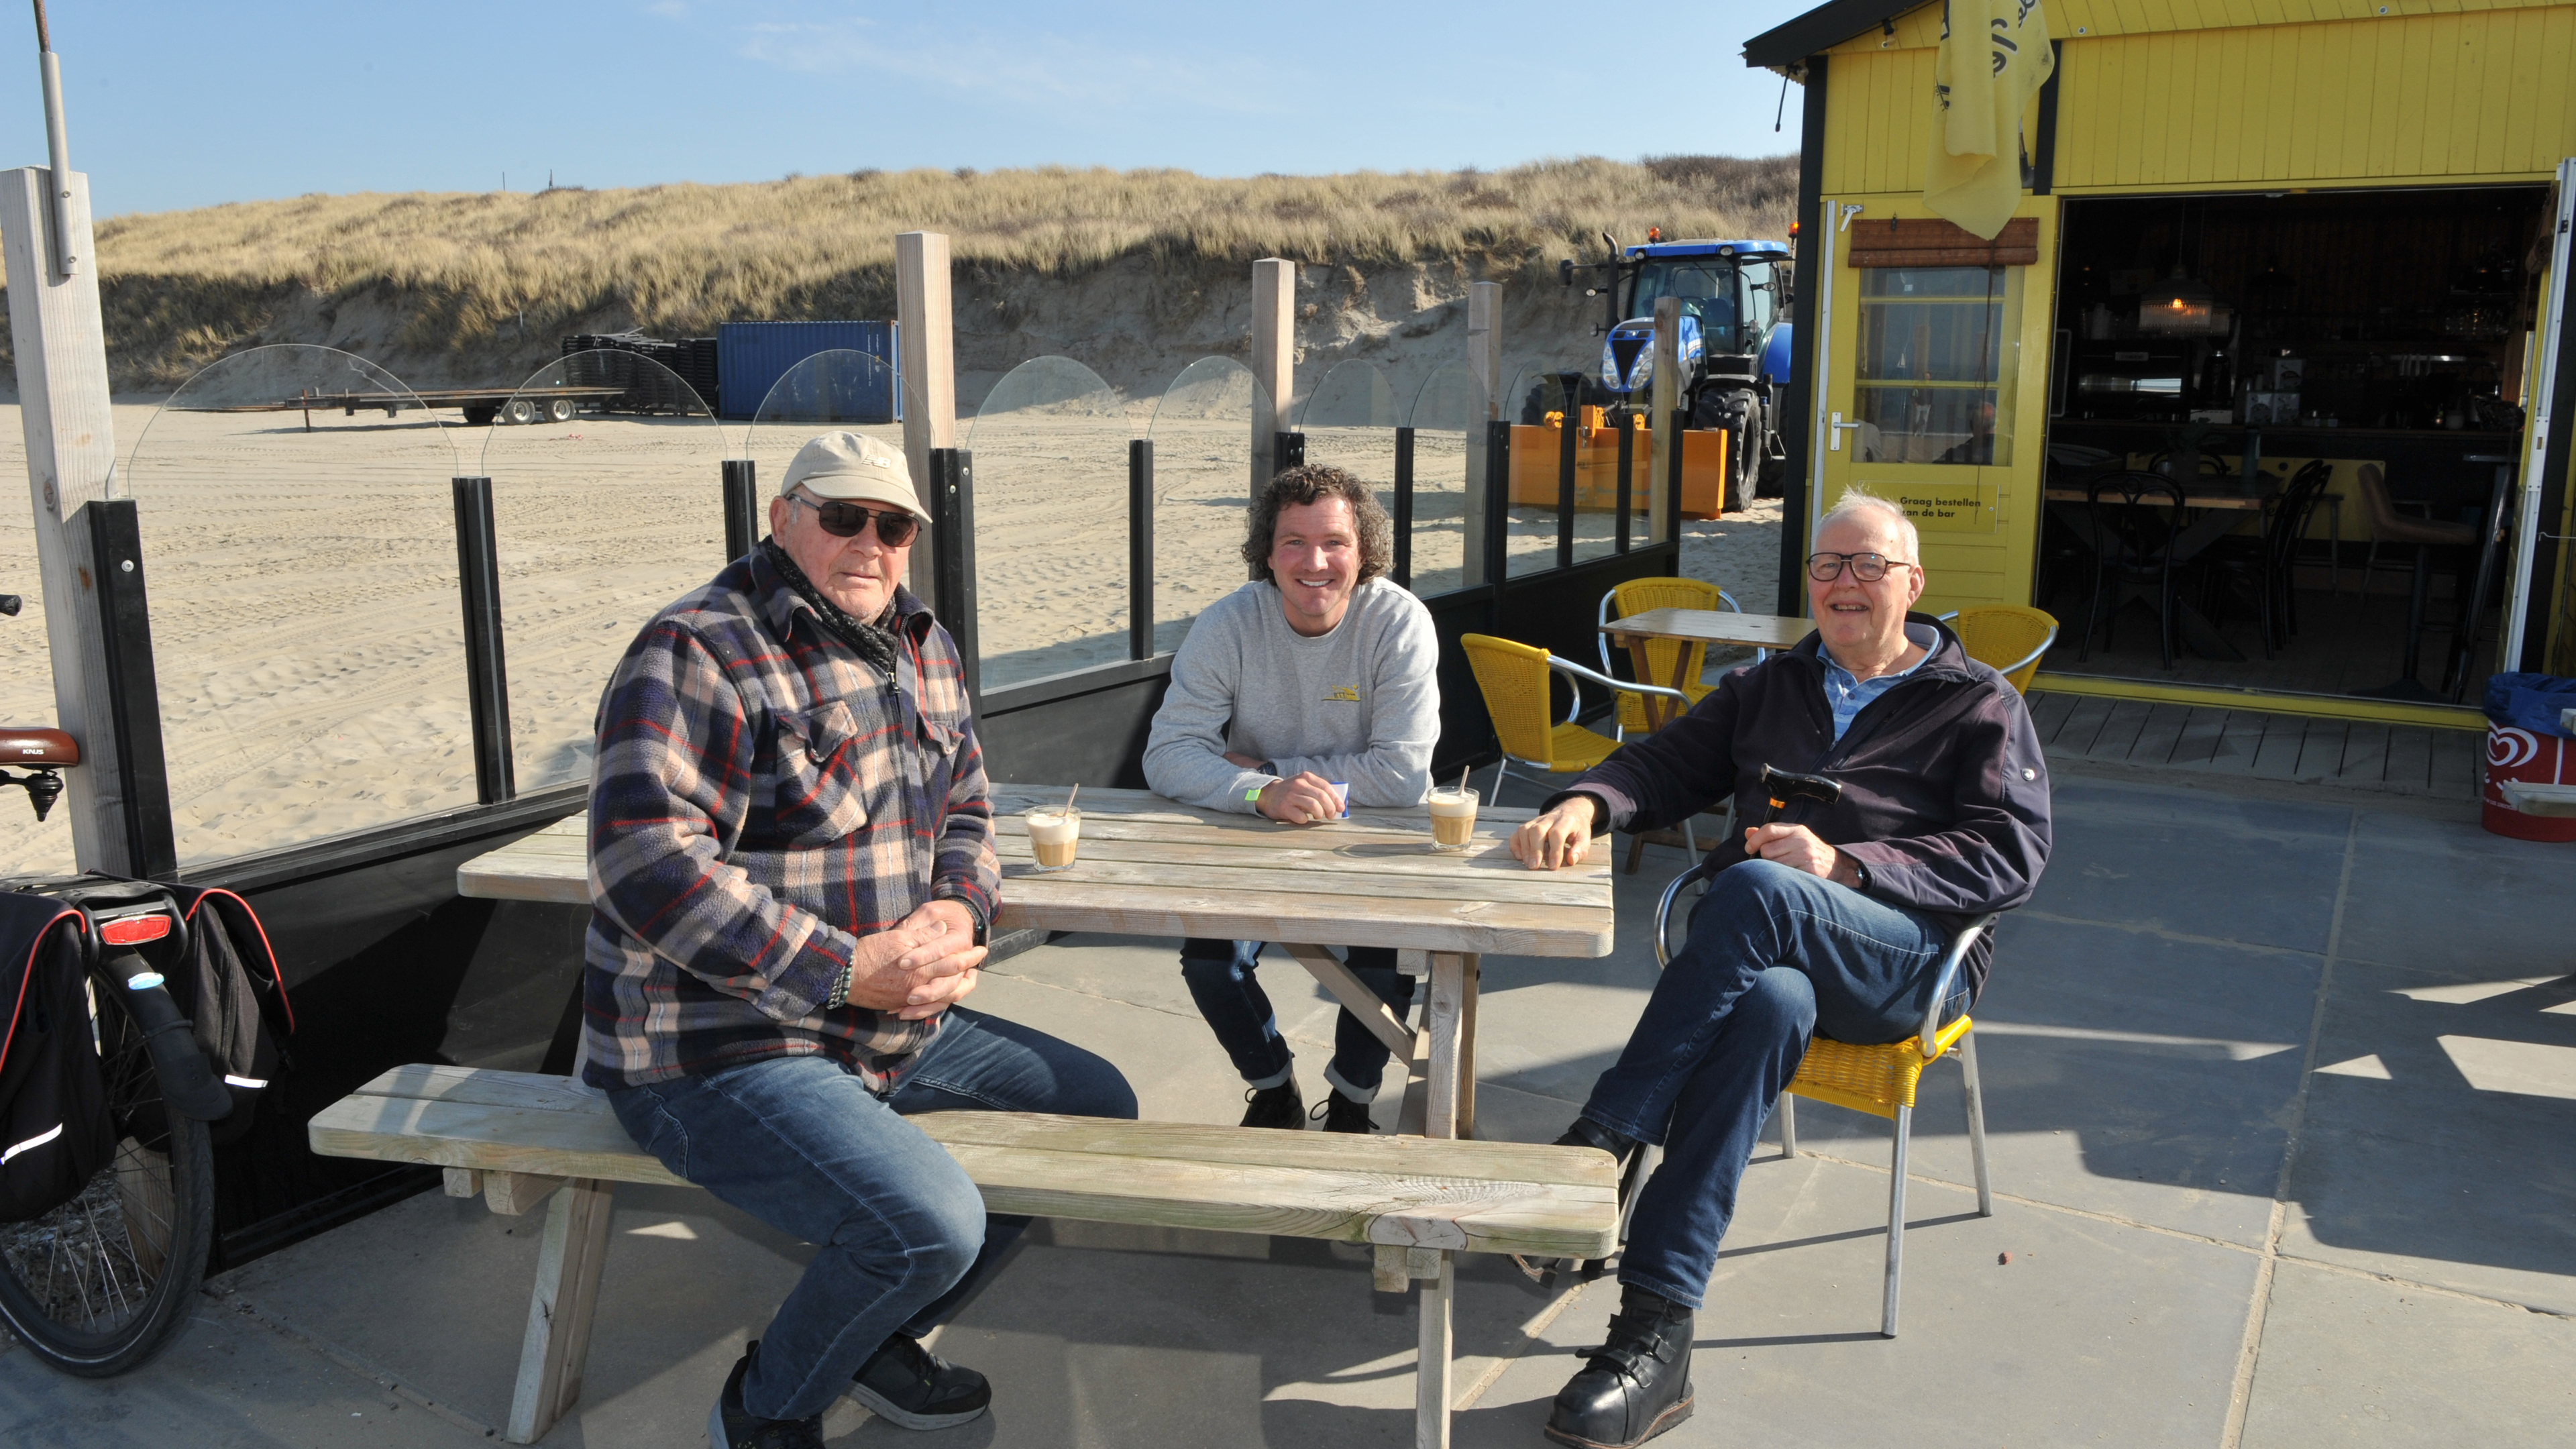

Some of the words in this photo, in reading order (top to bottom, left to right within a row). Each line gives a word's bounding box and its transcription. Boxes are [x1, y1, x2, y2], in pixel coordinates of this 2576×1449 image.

[1900, 496, 1932, 507] Graag
[1935, 497, 1981, 506] bestellen
[1922, 508, 1934, 517] de
[1937, 509, 1955, 517] bar
